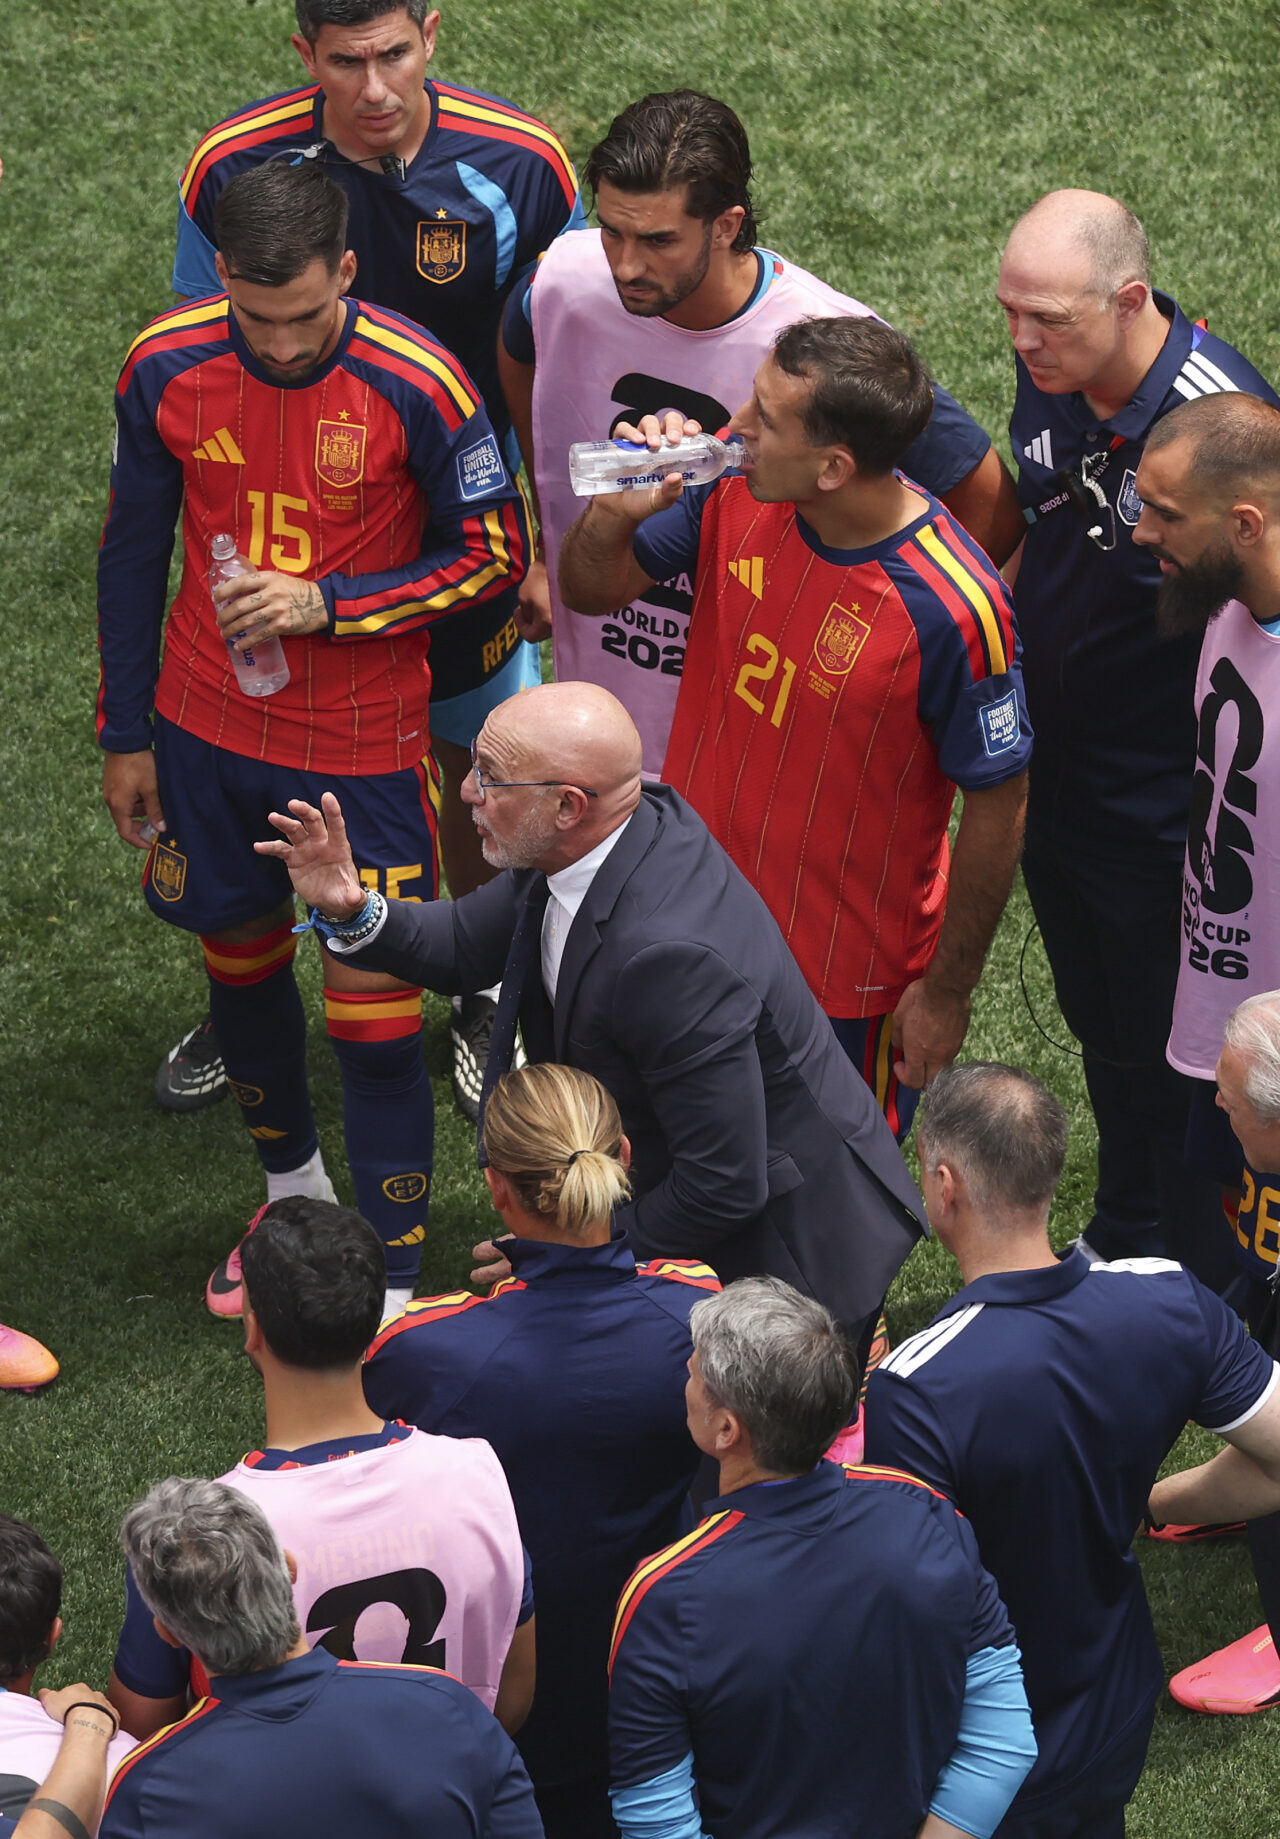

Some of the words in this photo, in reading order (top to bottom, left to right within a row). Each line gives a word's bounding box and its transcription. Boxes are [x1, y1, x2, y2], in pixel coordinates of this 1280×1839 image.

[463, 444, 493, 463] FOOTBALL
[464, 452, 496, 473] UNITES
[616, 471, 695, 486] smartwer
[247, 490, 311, 574] 15
[601, 623, 686, 678] 202
[734, 633, 797, 729] 21
[989, 706, 1015, 731] UNITES
[1202, 921, 1251, 946] CUP
